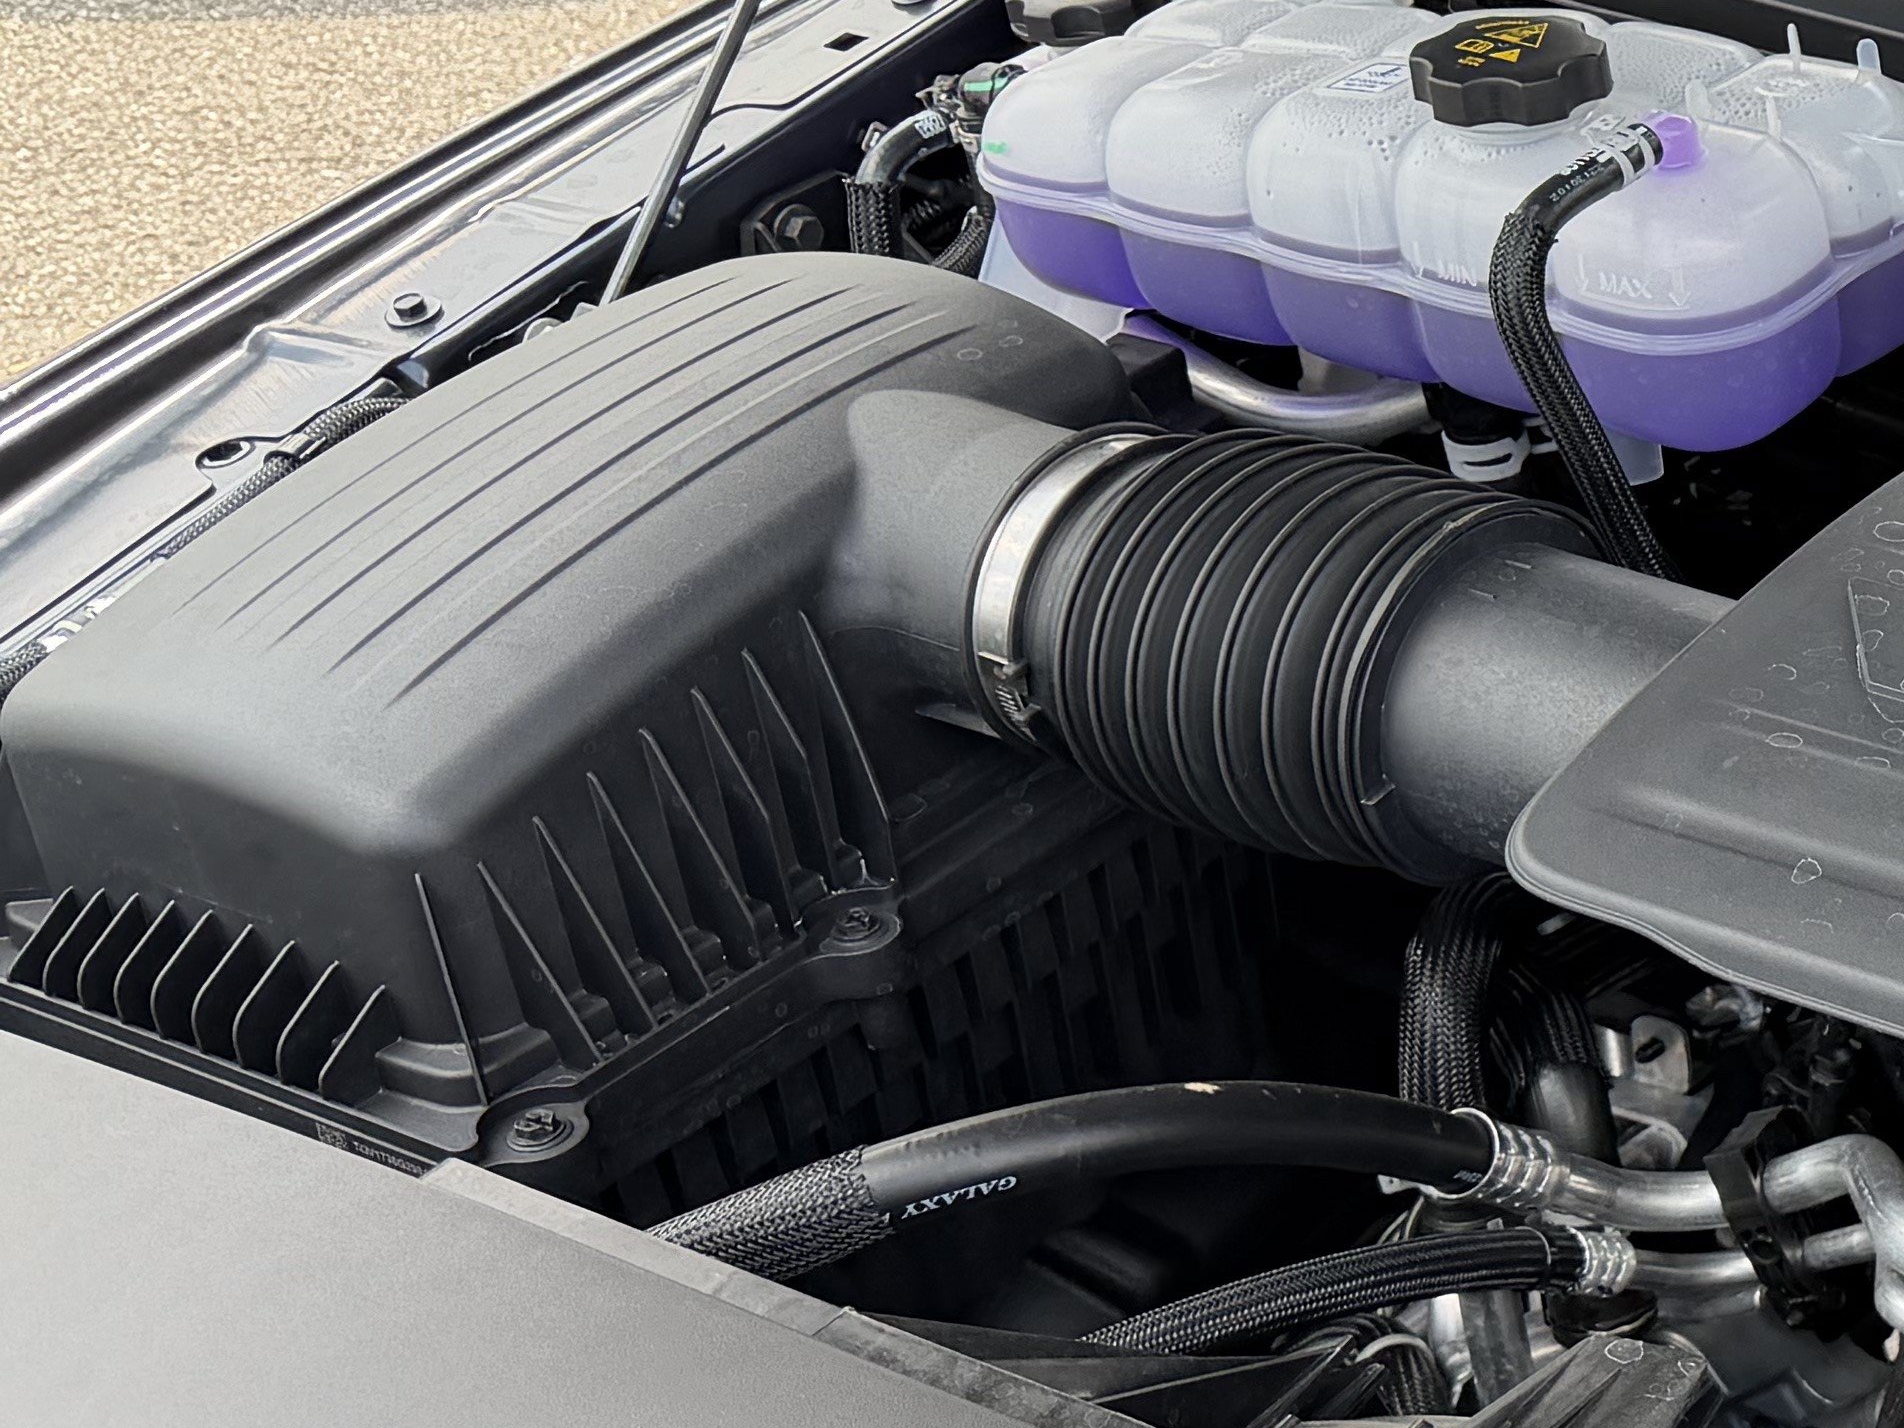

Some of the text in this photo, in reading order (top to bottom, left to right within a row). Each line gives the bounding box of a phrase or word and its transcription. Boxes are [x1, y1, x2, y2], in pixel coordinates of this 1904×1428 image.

[1437, 259, 1477, 287] MIN
[1599, 271, 1652, 300] MAX
[901, 1173, 1018, 1221] GALAXY
